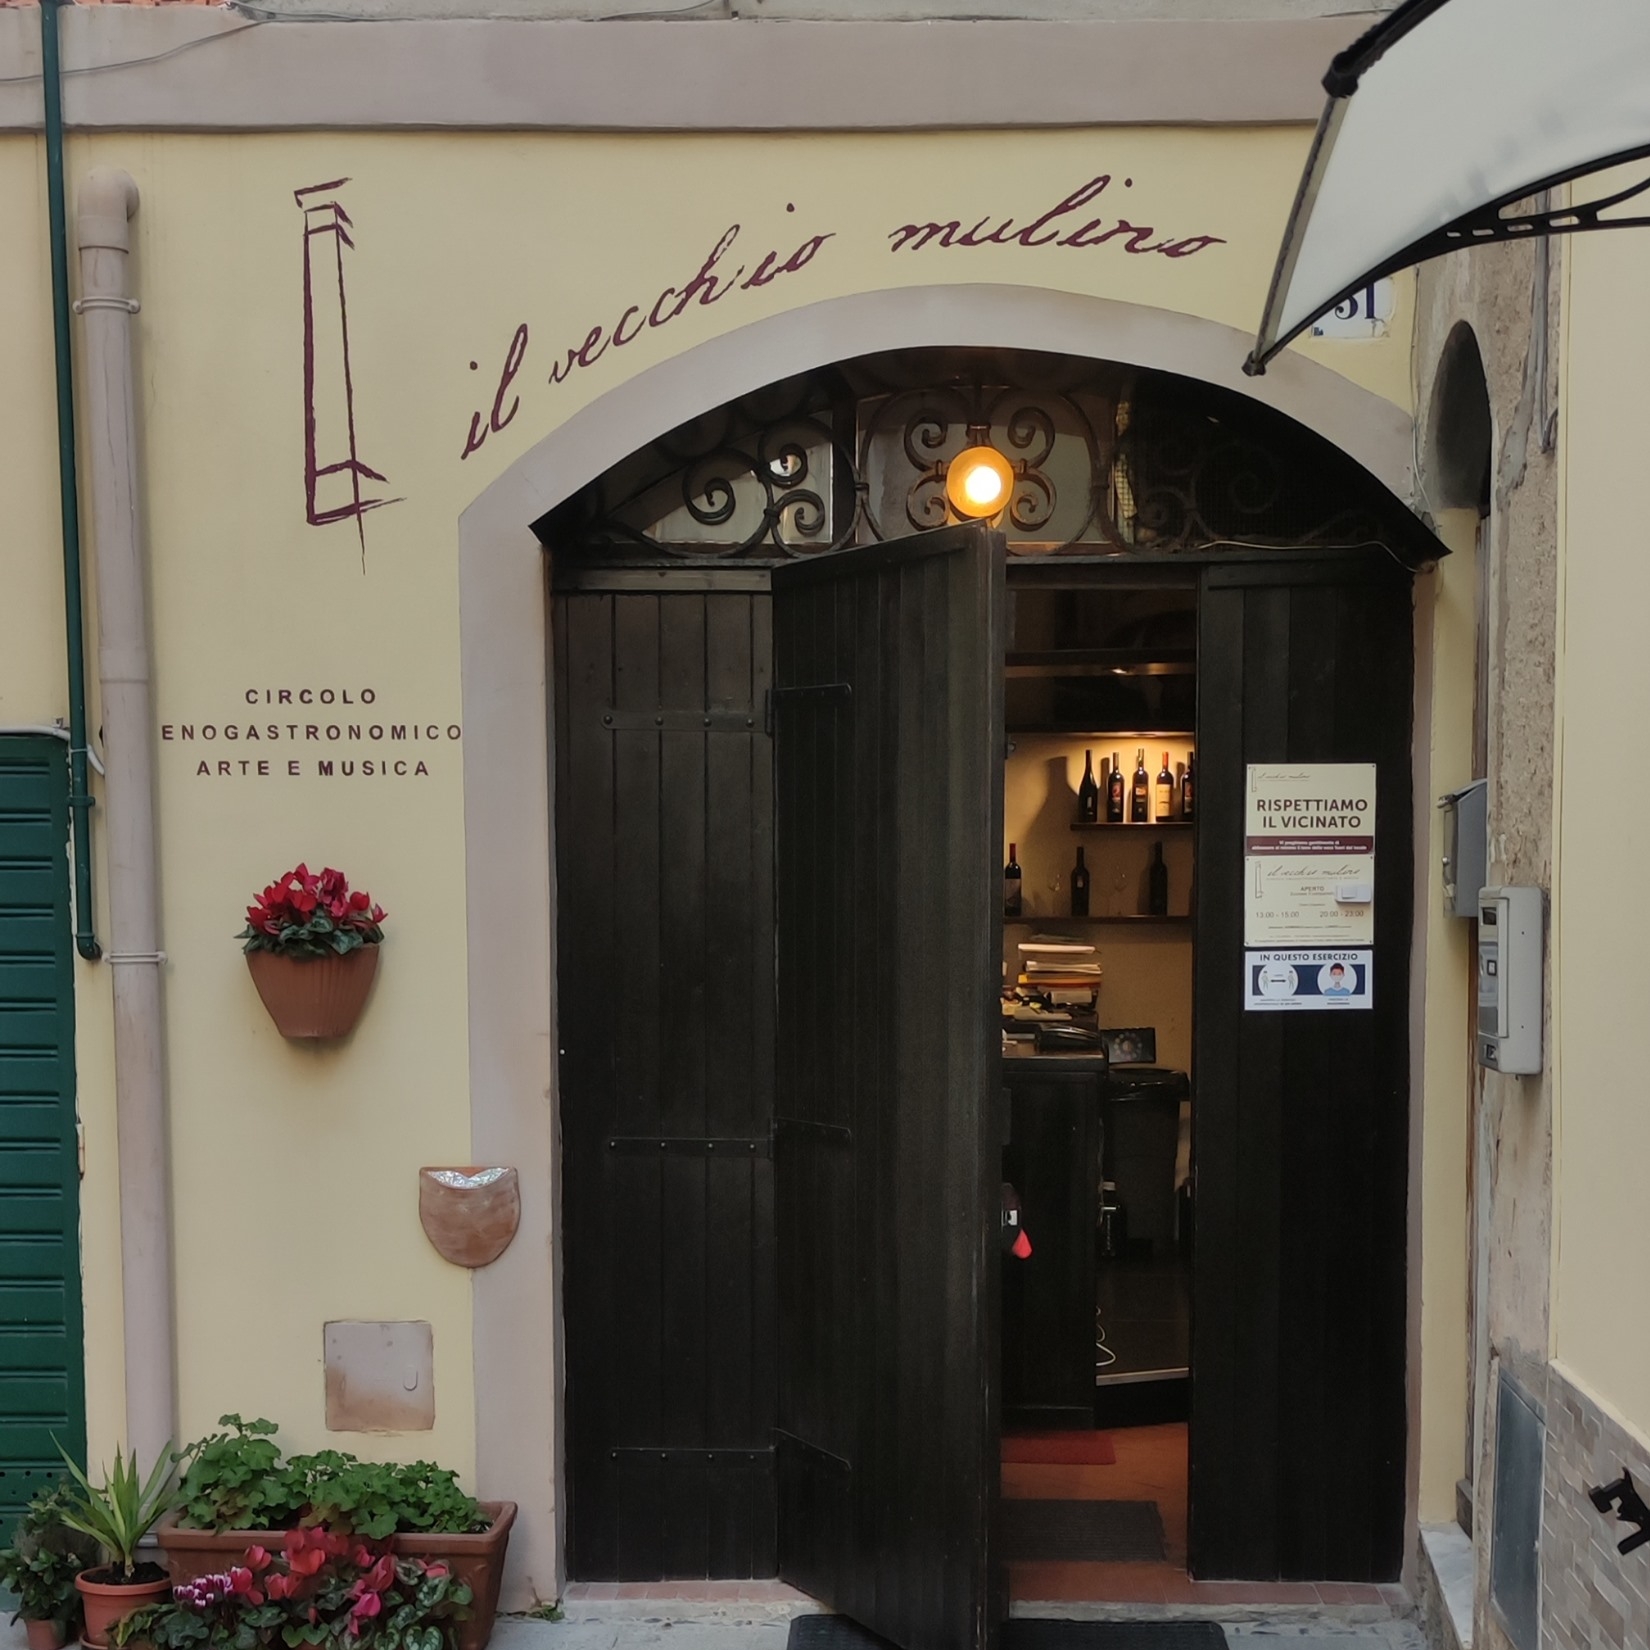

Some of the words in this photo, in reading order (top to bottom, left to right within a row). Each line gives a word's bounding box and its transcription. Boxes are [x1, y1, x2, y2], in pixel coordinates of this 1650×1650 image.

[461, 322, 528, 460] il
[547, 203, 836, 385] vecchio
[887, 174, 1227, 259] mulino
[245, 688, 376, 704] CIRCOLO
[161, 724, 462, 740] ENOGASTRONOMICO
[196, 760, 270, 776] ARTE
[287, 760, 301, 776] E
[318, 760, 430, 776] MUSICA
[1256, 799, 1368, 812] RISPETTIAMO
[1262, 816, 1278, 829] IL
[1280, 816, 1362, 829] VICINATO
[1260, 953, 1271, 961] IN
[1273, 953, 1310, 961] QUESTO
[1312, 953, 1358, 961] ESERCIZIO
